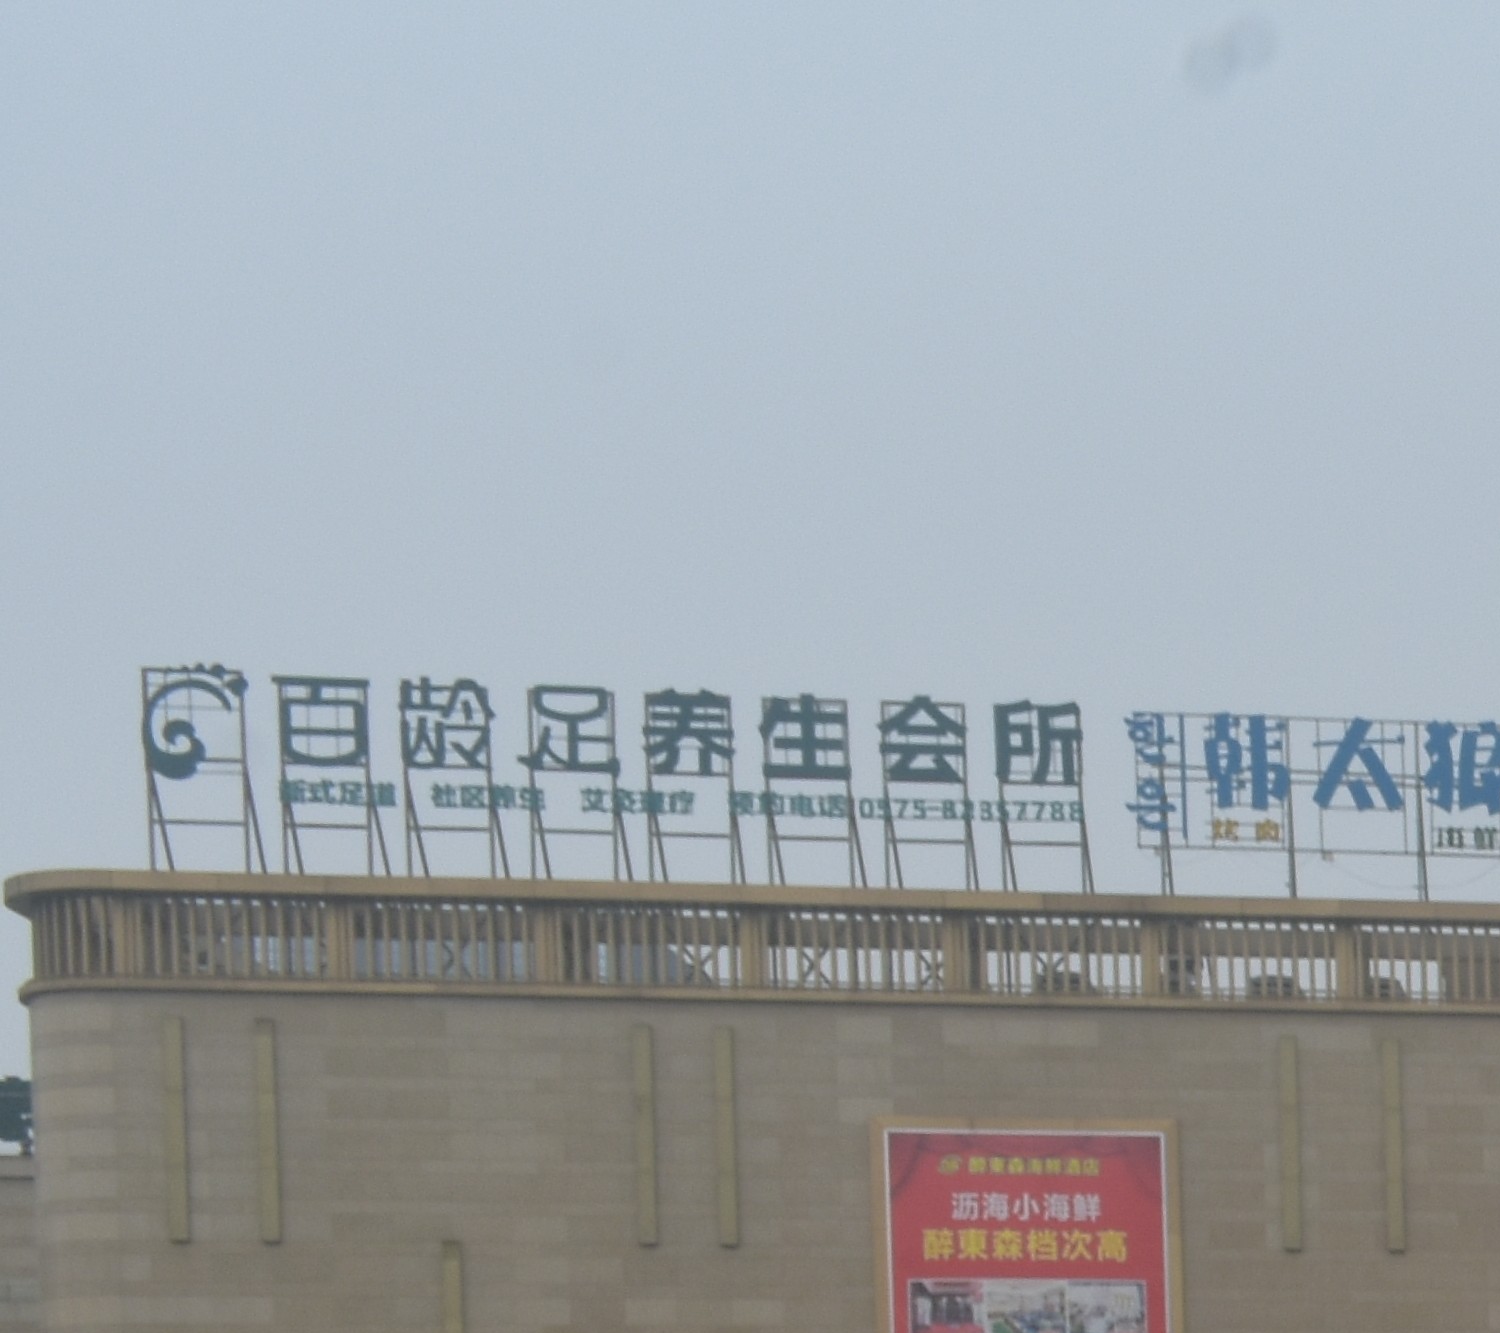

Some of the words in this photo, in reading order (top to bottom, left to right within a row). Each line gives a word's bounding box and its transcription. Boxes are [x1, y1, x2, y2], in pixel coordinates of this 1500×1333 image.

[272, 675, 1083, 785] 百龄足养生会所
[951, 1191, 1102, 1223] 沥海小海鲜
